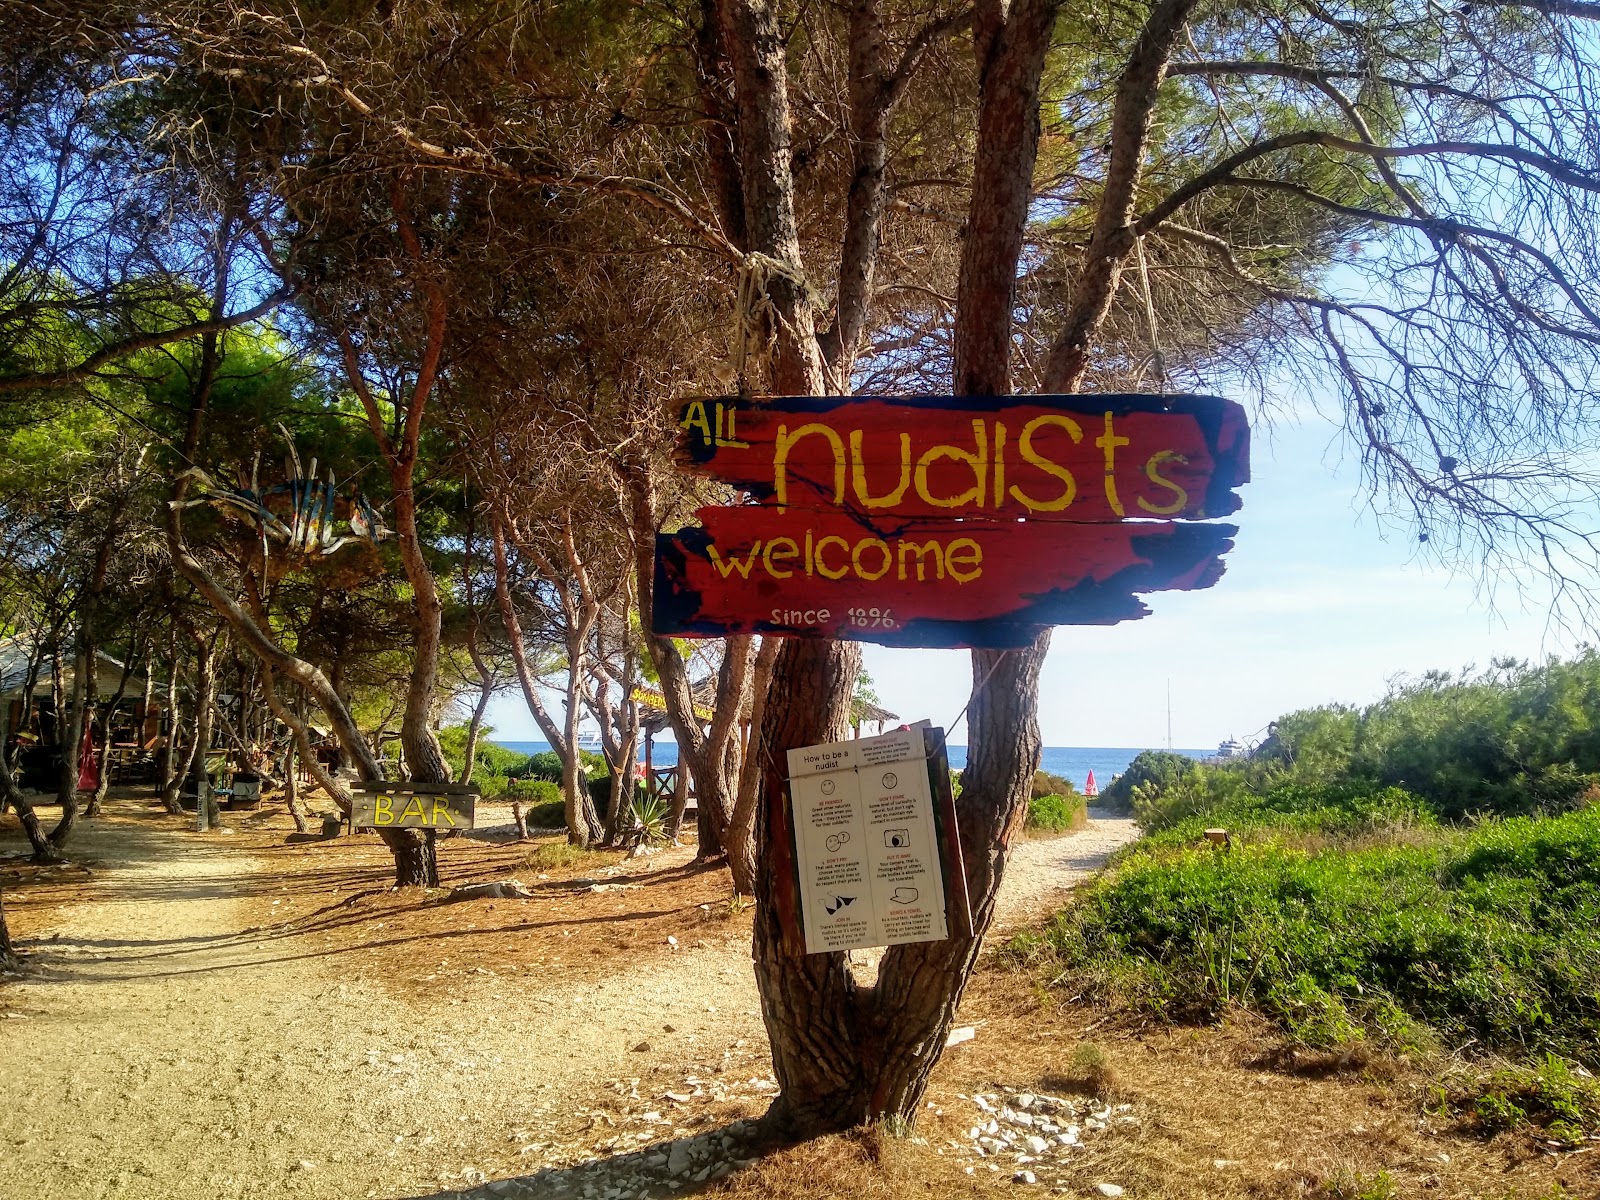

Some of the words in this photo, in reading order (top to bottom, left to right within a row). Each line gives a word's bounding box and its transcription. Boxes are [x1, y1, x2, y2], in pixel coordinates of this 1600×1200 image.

[680, 402, 750, 449] ALL
[705, 528, 984, 584] welcome
[770, 608, 831, 626] since
[632, 688, 667, 709] SUNBEDS
[816, 761, 838, 770] nudist
[374, 794, 457, 826] BAR
